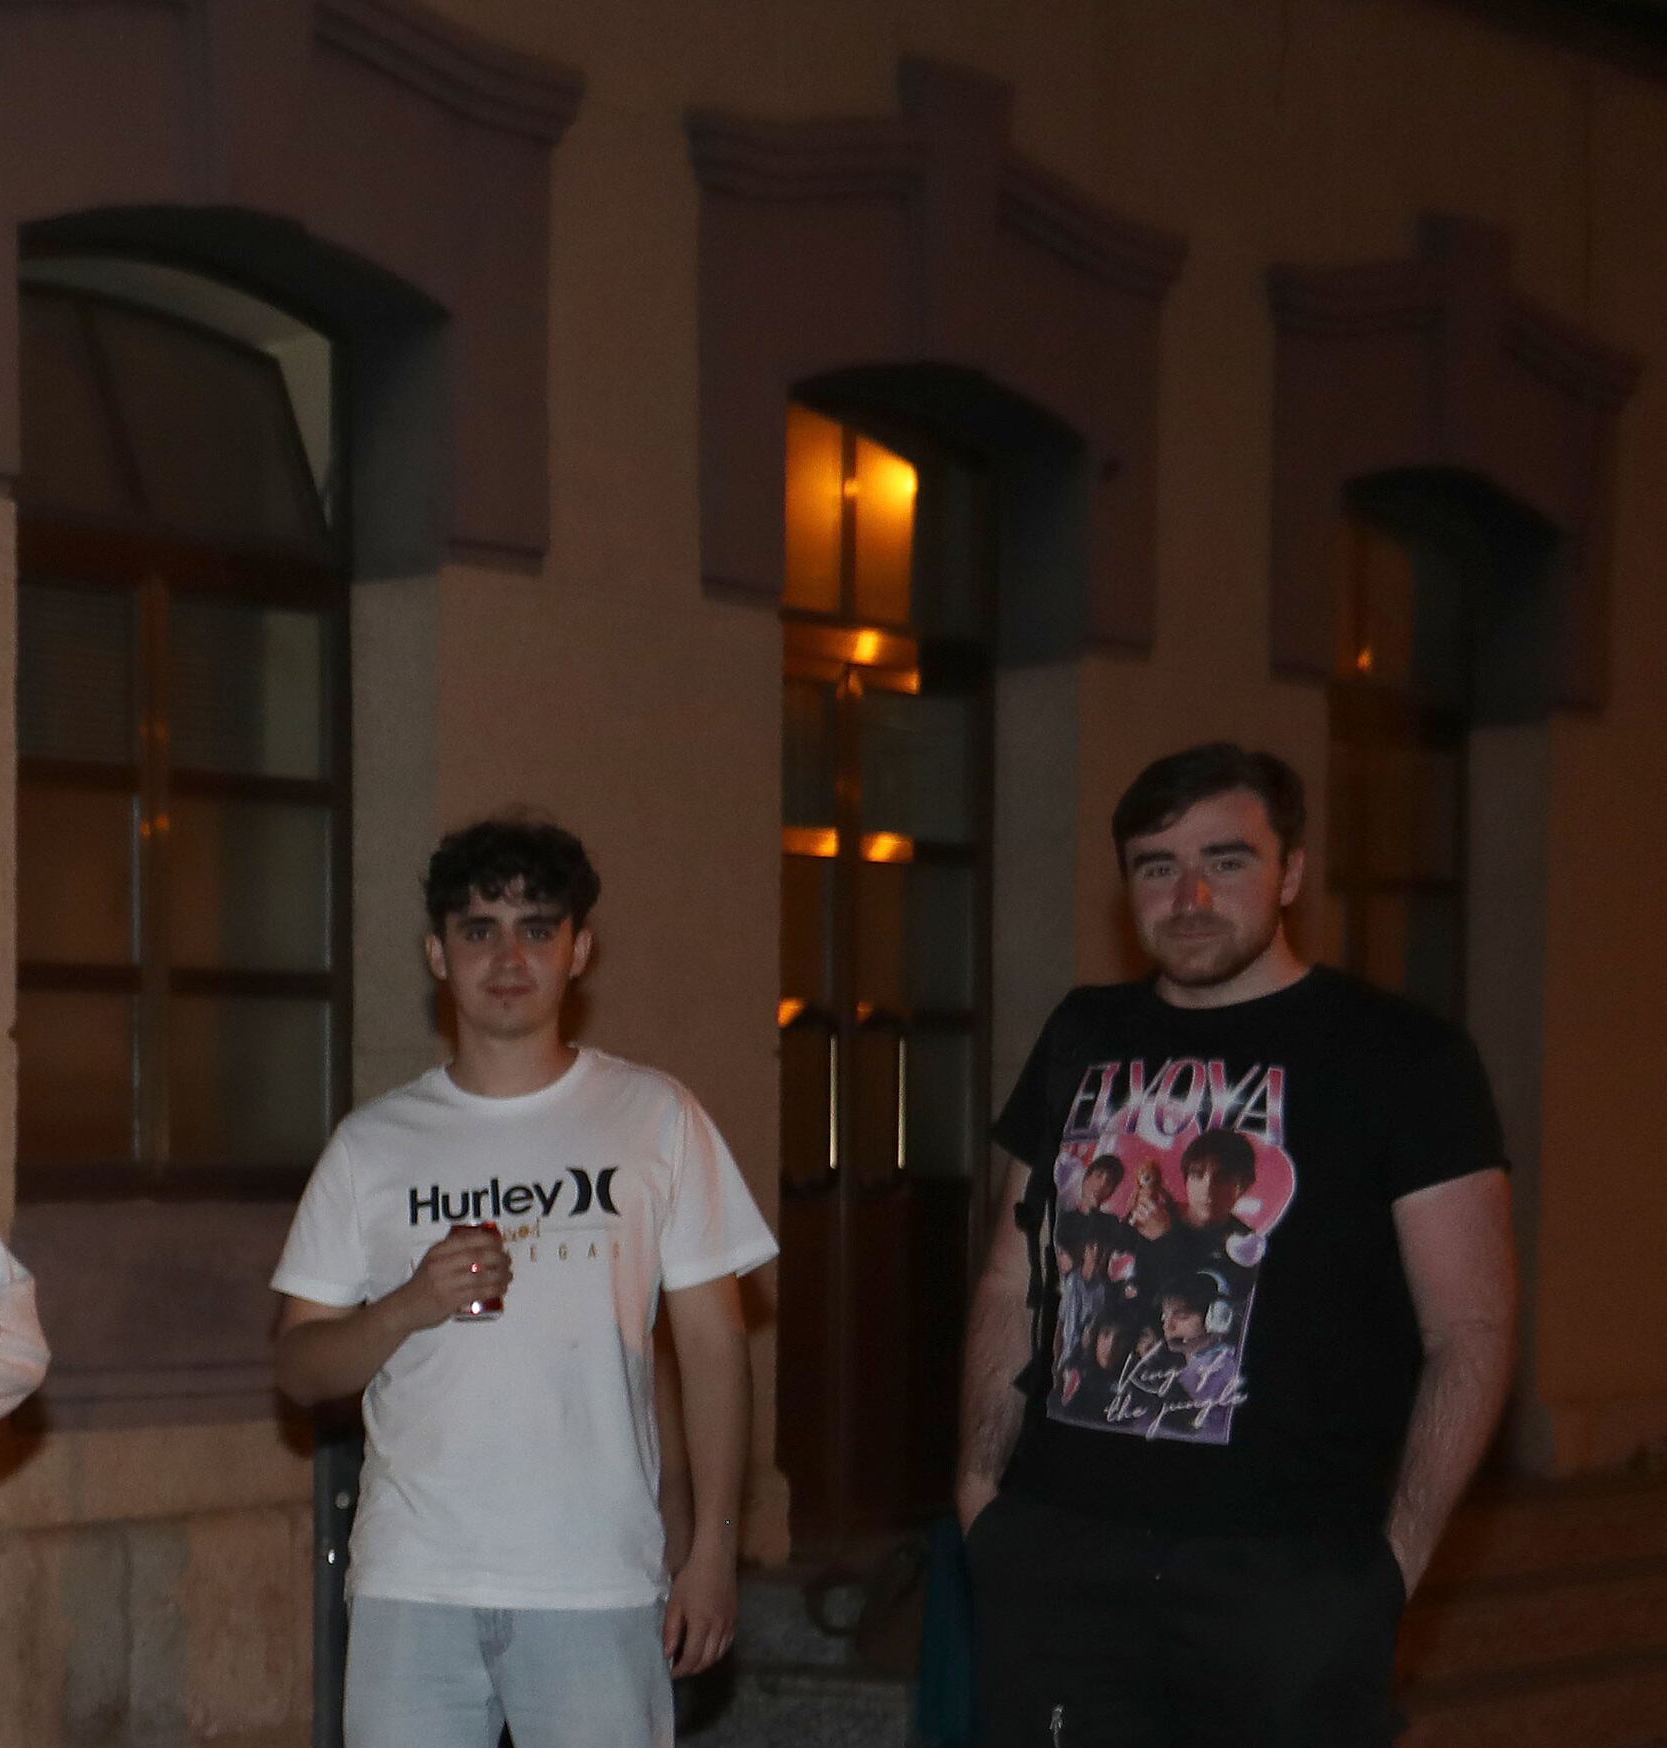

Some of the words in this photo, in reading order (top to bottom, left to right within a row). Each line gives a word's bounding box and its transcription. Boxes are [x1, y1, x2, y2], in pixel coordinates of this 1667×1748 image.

[409, 1177, 563, 1225] Hurley
[1116, 1340, 1182, 1397] King
[1103, 1392, 1148, 1423] the
